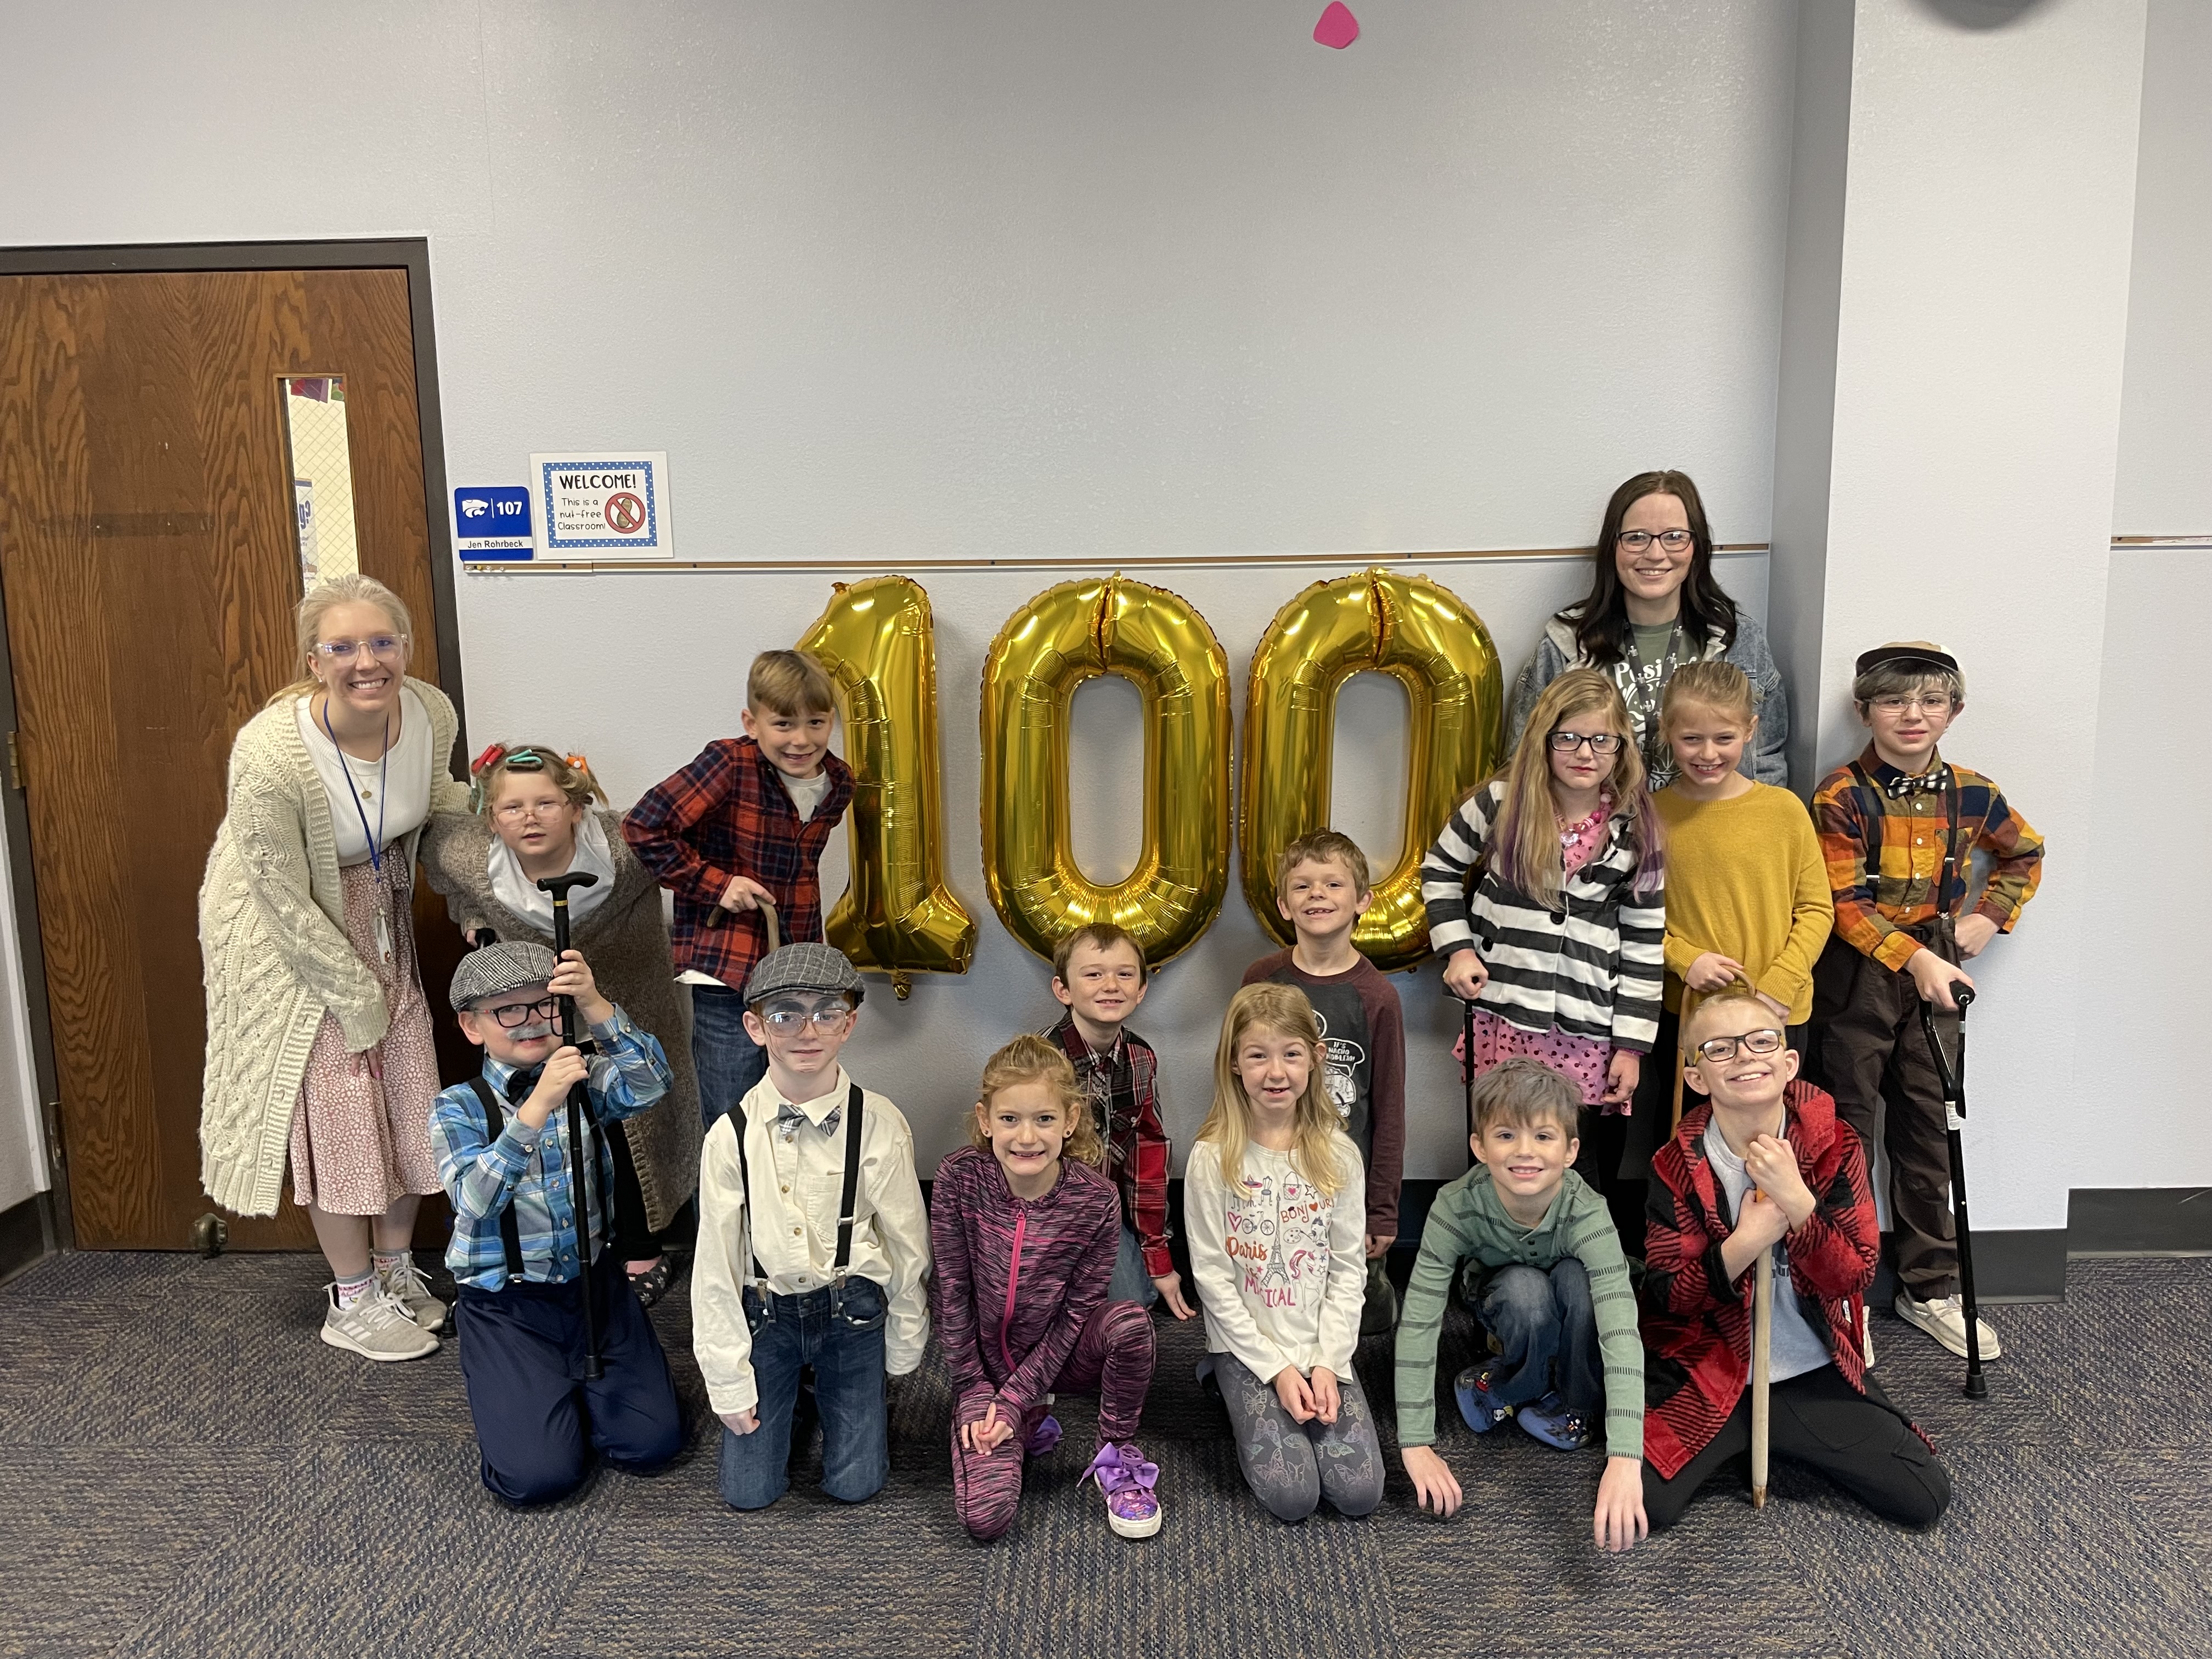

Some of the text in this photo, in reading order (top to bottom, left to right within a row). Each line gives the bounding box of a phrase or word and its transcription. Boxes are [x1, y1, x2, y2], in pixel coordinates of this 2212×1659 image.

[559, 473, 636, 489] WELCOME!
[561, 498, 580, 506] This
[583, 498, 590, 506] is
[496, 501, 522, 515] 107
[560, 510, 601, 518] nut-free
[557, 522, 606, 531] Classroom!
[467, 539, 523, 549] Jen Rohrbeck
[1325, 1053, 1355, 1062] ROBLEM!
